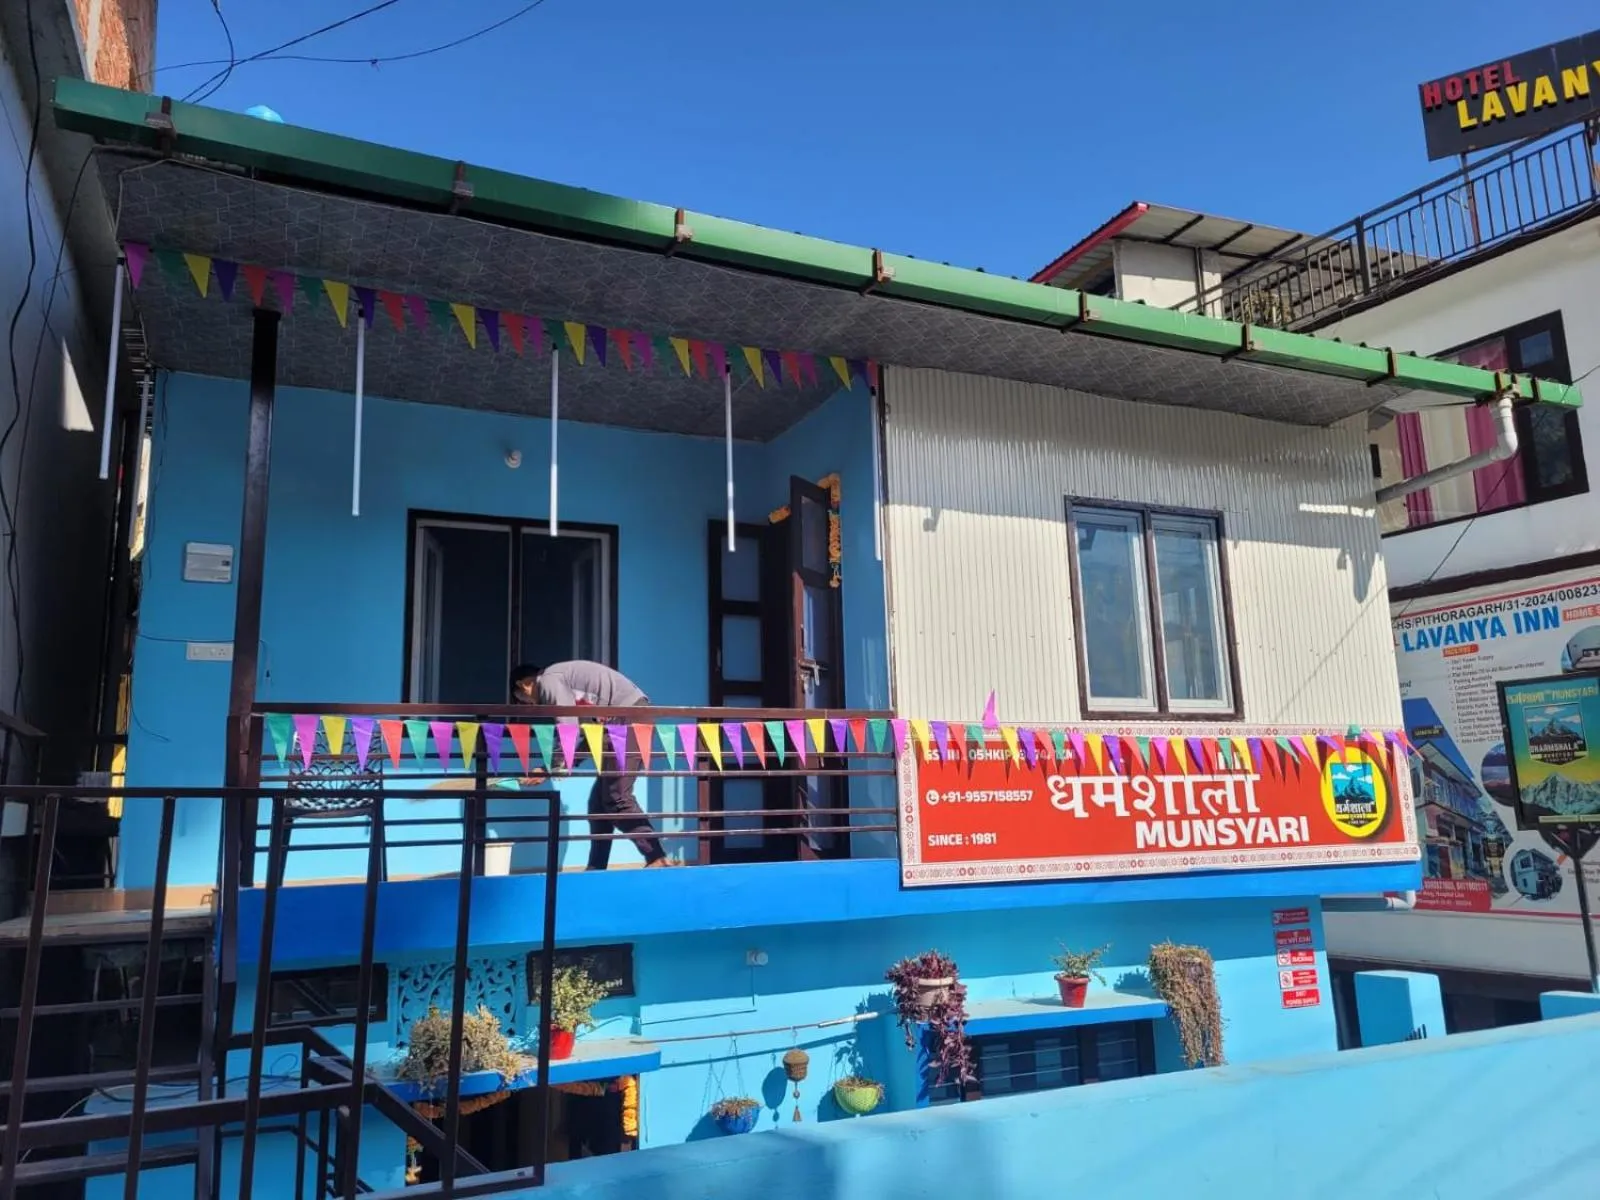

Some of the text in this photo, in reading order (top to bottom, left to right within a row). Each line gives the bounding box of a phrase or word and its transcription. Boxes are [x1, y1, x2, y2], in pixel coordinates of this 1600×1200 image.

[1423, 61, 1521, 109] HOTEL
[1402, 616, 1506, 652] LAVANYA
[1513, 605, 1560, 634] INN
[941, 789, 1033, 803] +91-9557158557
[1047, 759, 1261, 818] धर्मशाला
[928, 833, 963, 847] SINCE
[971, 832, 997, 845] 1981
[1135, 815, 1310, 849] MUNSYARI
